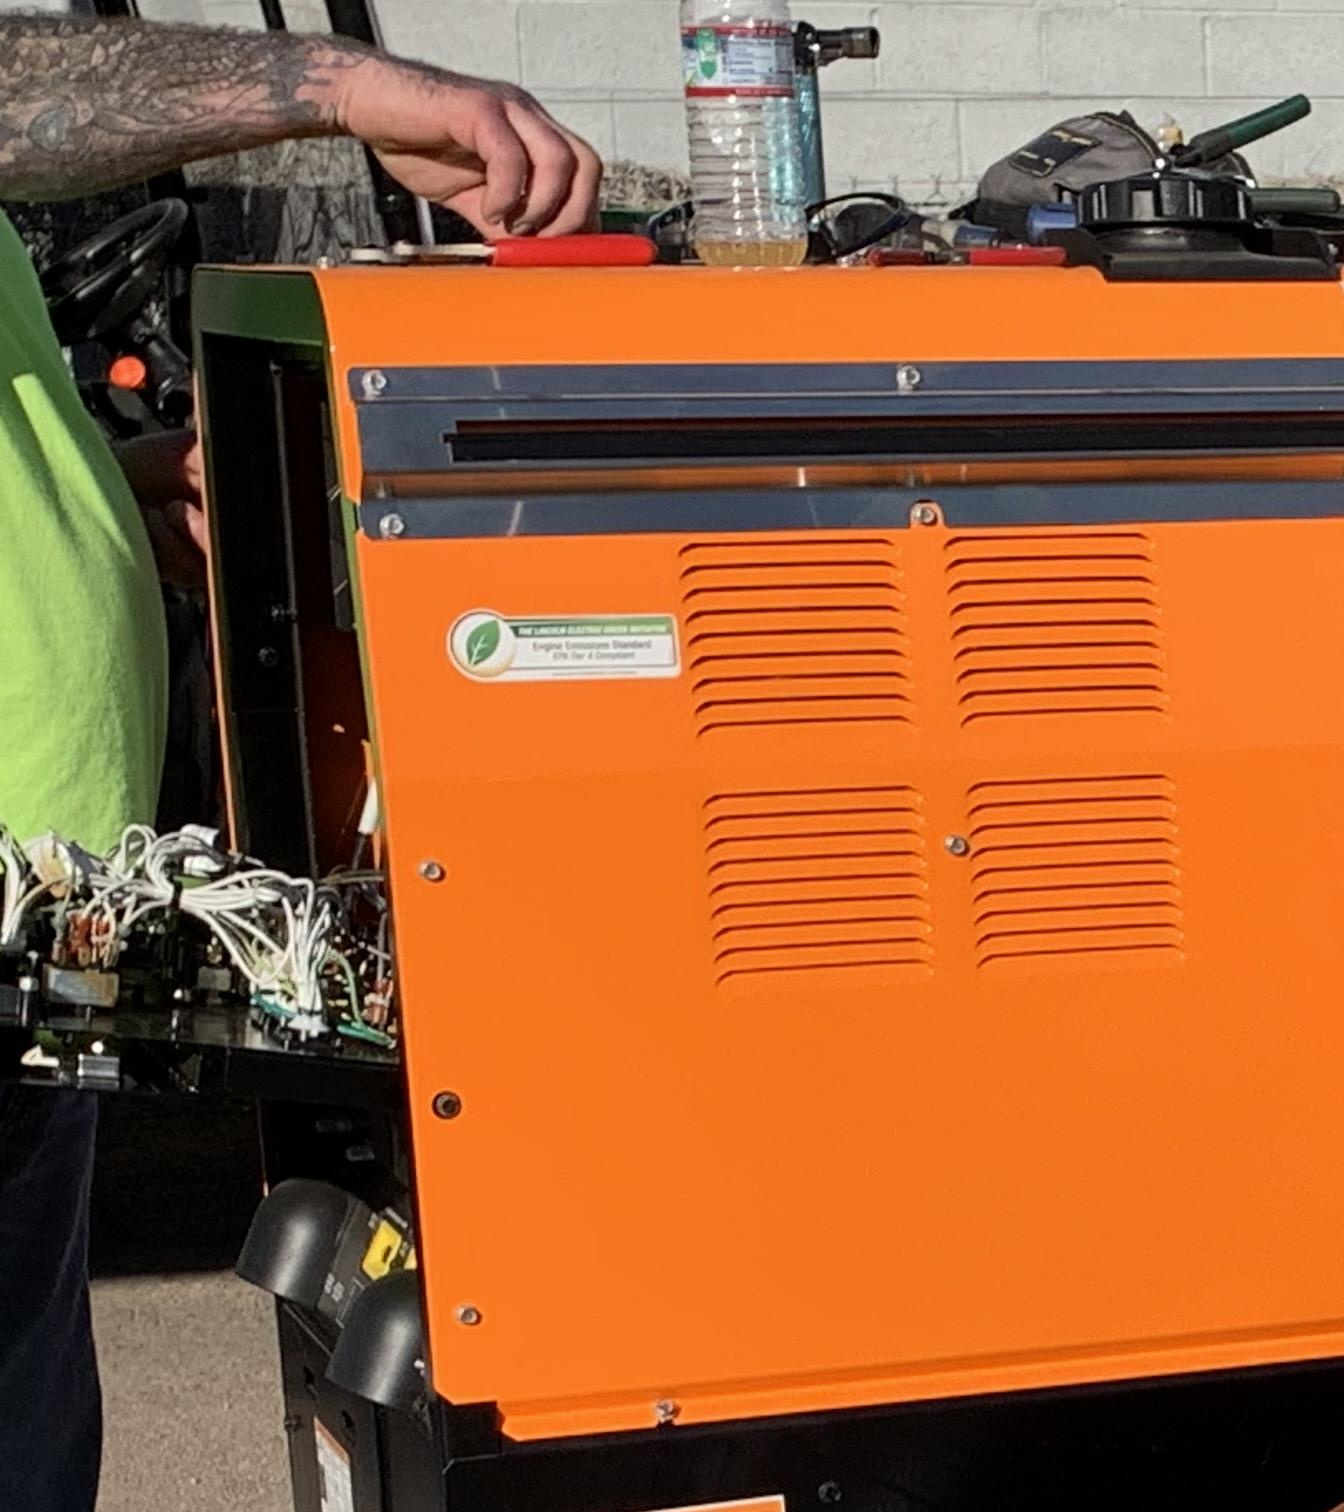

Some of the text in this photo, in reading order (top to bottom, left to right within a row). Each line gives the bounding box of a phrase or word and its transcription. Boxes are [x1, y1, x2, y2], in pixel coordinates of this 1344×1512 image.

[532, 639, 653, 653] Engine Emissions Standard
